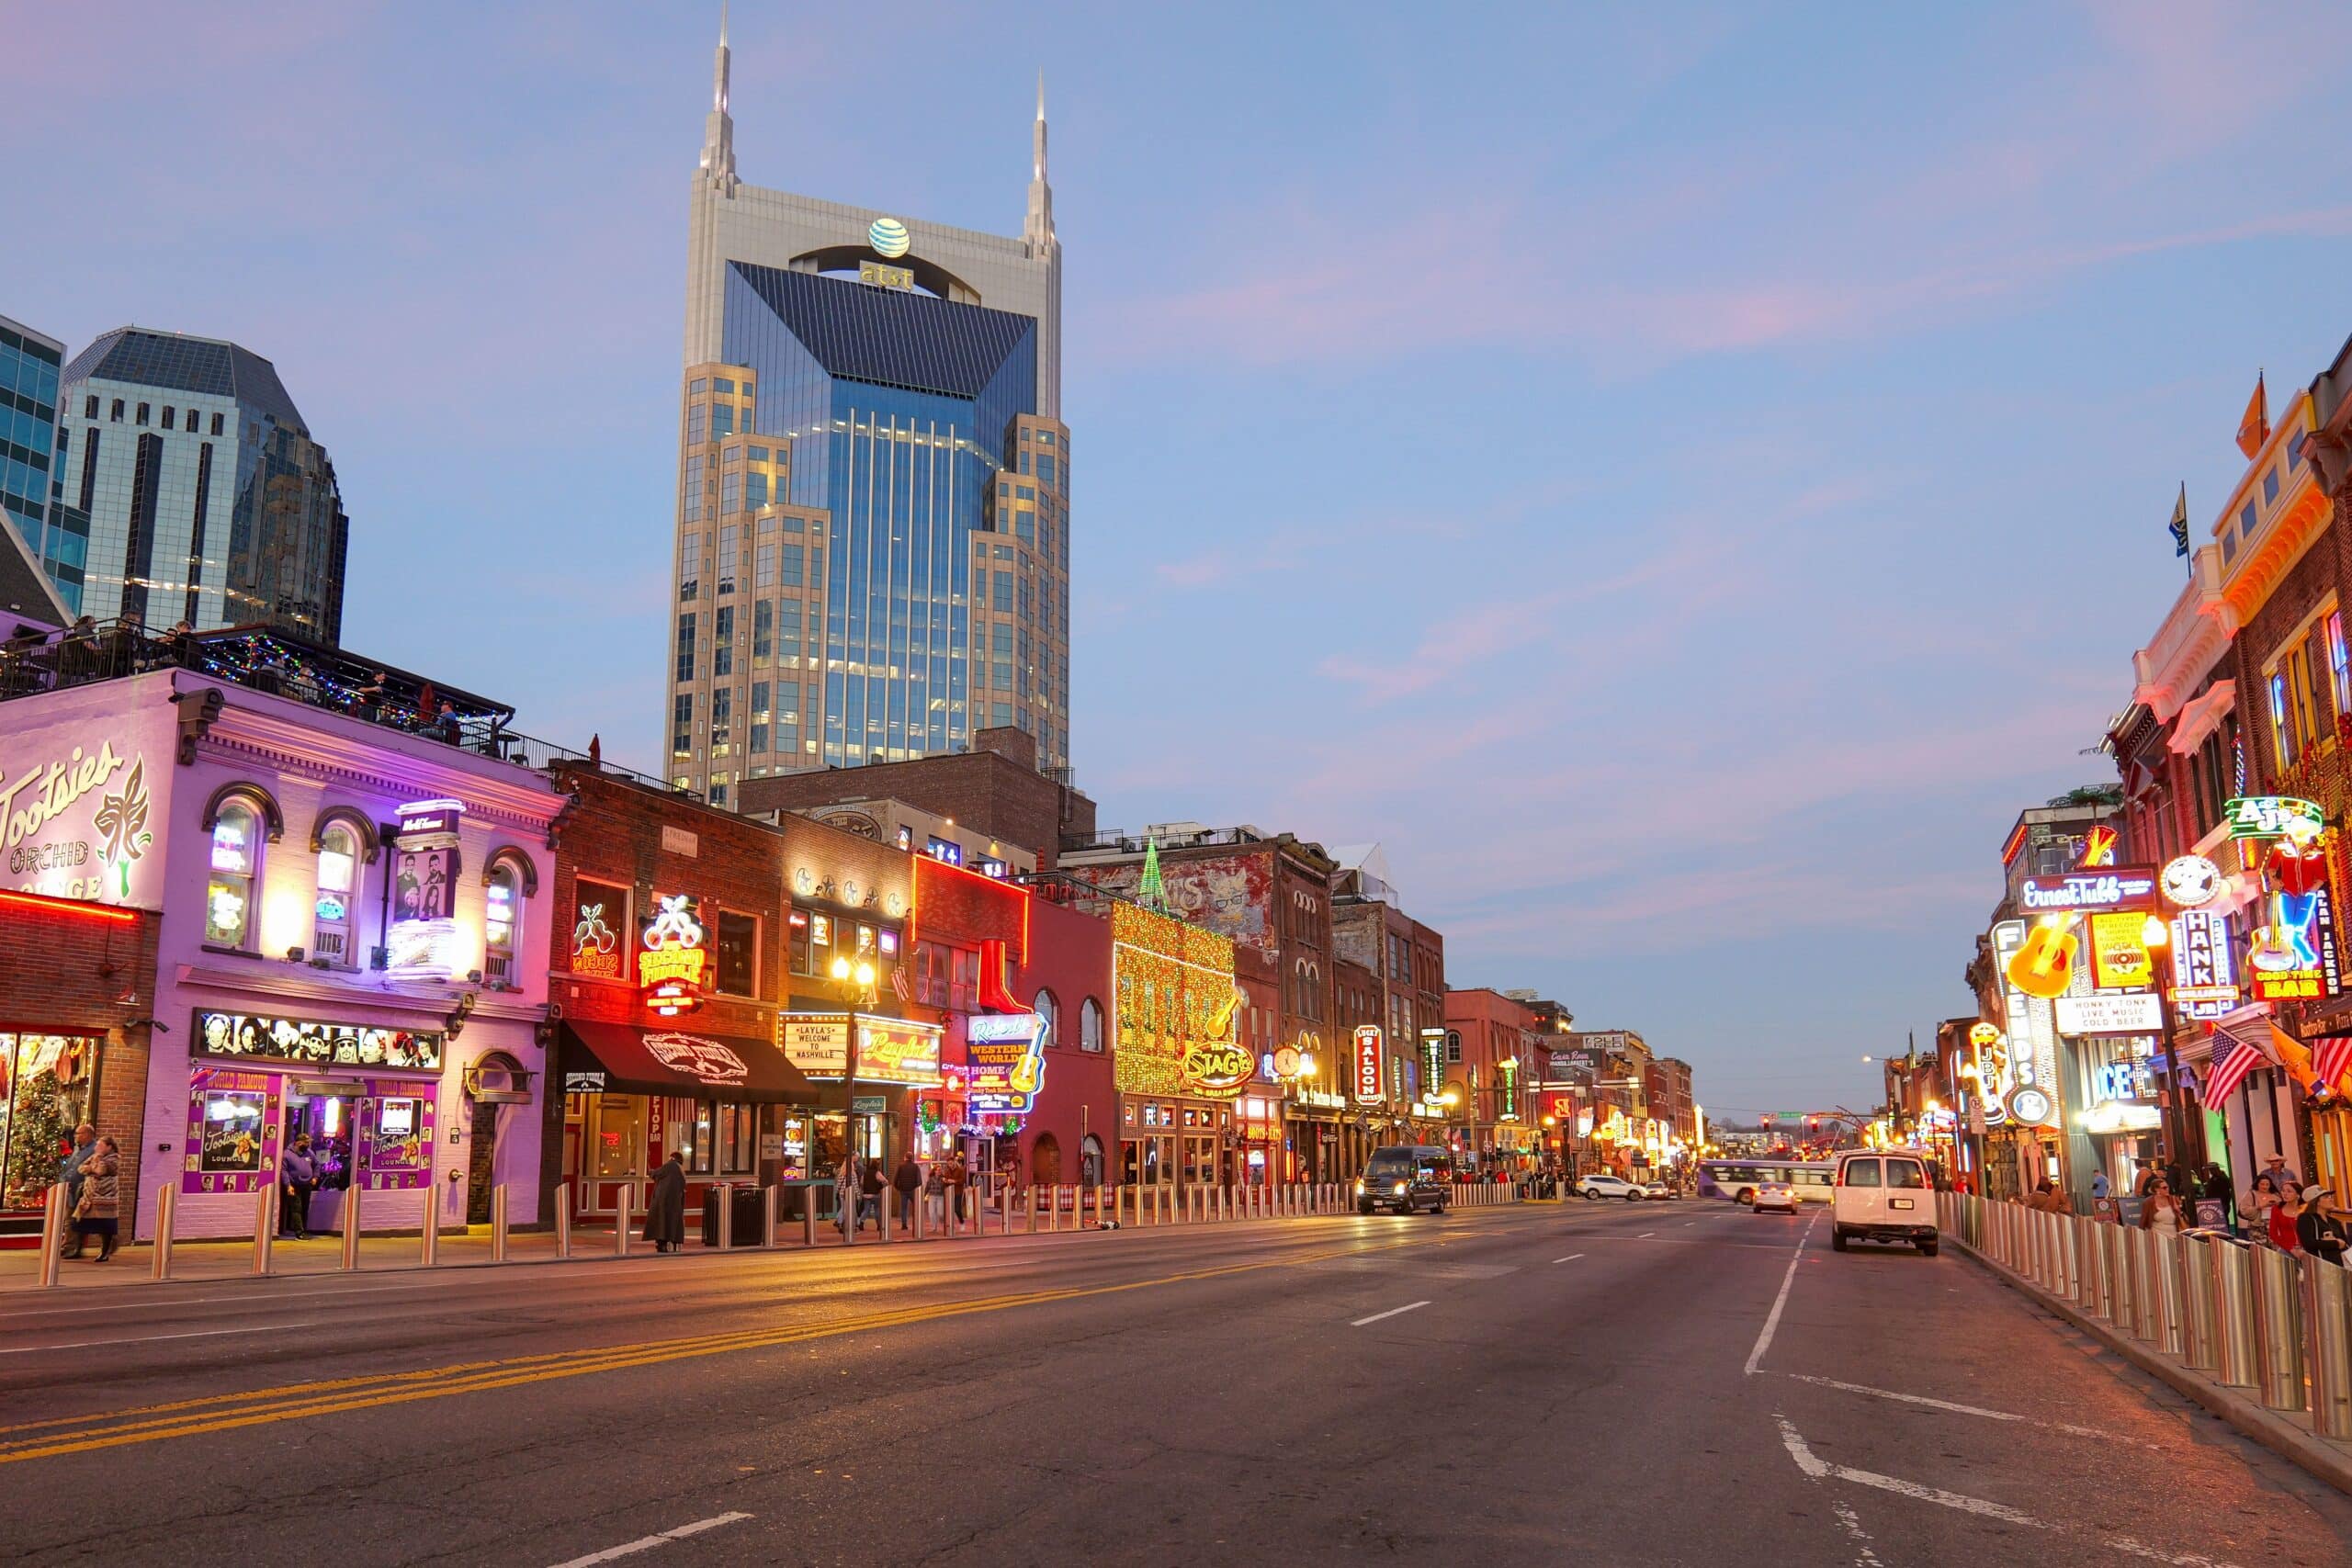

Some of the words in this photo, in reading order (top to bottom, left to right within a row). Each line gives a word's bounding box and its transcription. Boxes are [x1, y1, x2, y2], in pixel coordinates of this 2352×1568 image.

[860, 265, 912, 290] at&t
[10, 840, 89, 874] ORCHID
[2024, 881, 2080, 908] Ernest
[2064, 876, 2121, 904] Tubb
[2317, 889, 2331, 925] ALAN
[639, 949, 705, 970] SECOND
[2188, 913, 2212, 985] HANK
[2323, 932, 2338, 995] JACKSON
[640, 964, 701, 988] FIDDLE
[2263, 979, 2320, 998] BAR
[1996, 928, 2034, 1085] FENDS
[2081, 1009, 2105, 1017] LIVE
[2112, 1008, 2145, 1016] MUSIC
[2195, 1003, 2217, 1015] JR
[1357, 1029, 1378, 1037] LUCKY
[2083, 1019, 2109, 1027] COLD
[2117, 1017, 2143, 1025] BEER
[649, 1041, 695, 1064] SECOND
[691, 1045, 744, 1070] FIDDLE
[797, 1051, 834, 1059] NASHVILLE
[864, 1032, 937, 1069] Layla's
[970, 1044, 1027, 1055] WESTERN
[977, 1055, 1019, 1064] WORLD
[971, 1066, 1005, 1075] HOME
[1185, 1049, 1252, 1079] STAGE
[1362, 1036, 1375, 1095] SALOON
[1429, 1039, 1439, 1094] WHISKEY
[1981, 1046, 1994, 1089] JBJ
[207, 1070, 234, 1088] WORLD
[237, 1072, 267, 1089] FAMOUS
[566, 1073, 585, 1088] SECOND
[585, 1073, 605, 1088] FIDDLE
[650, 1134, 662, 1142] BAR
[1247, 1127, 1266, 1140] BOOTS
